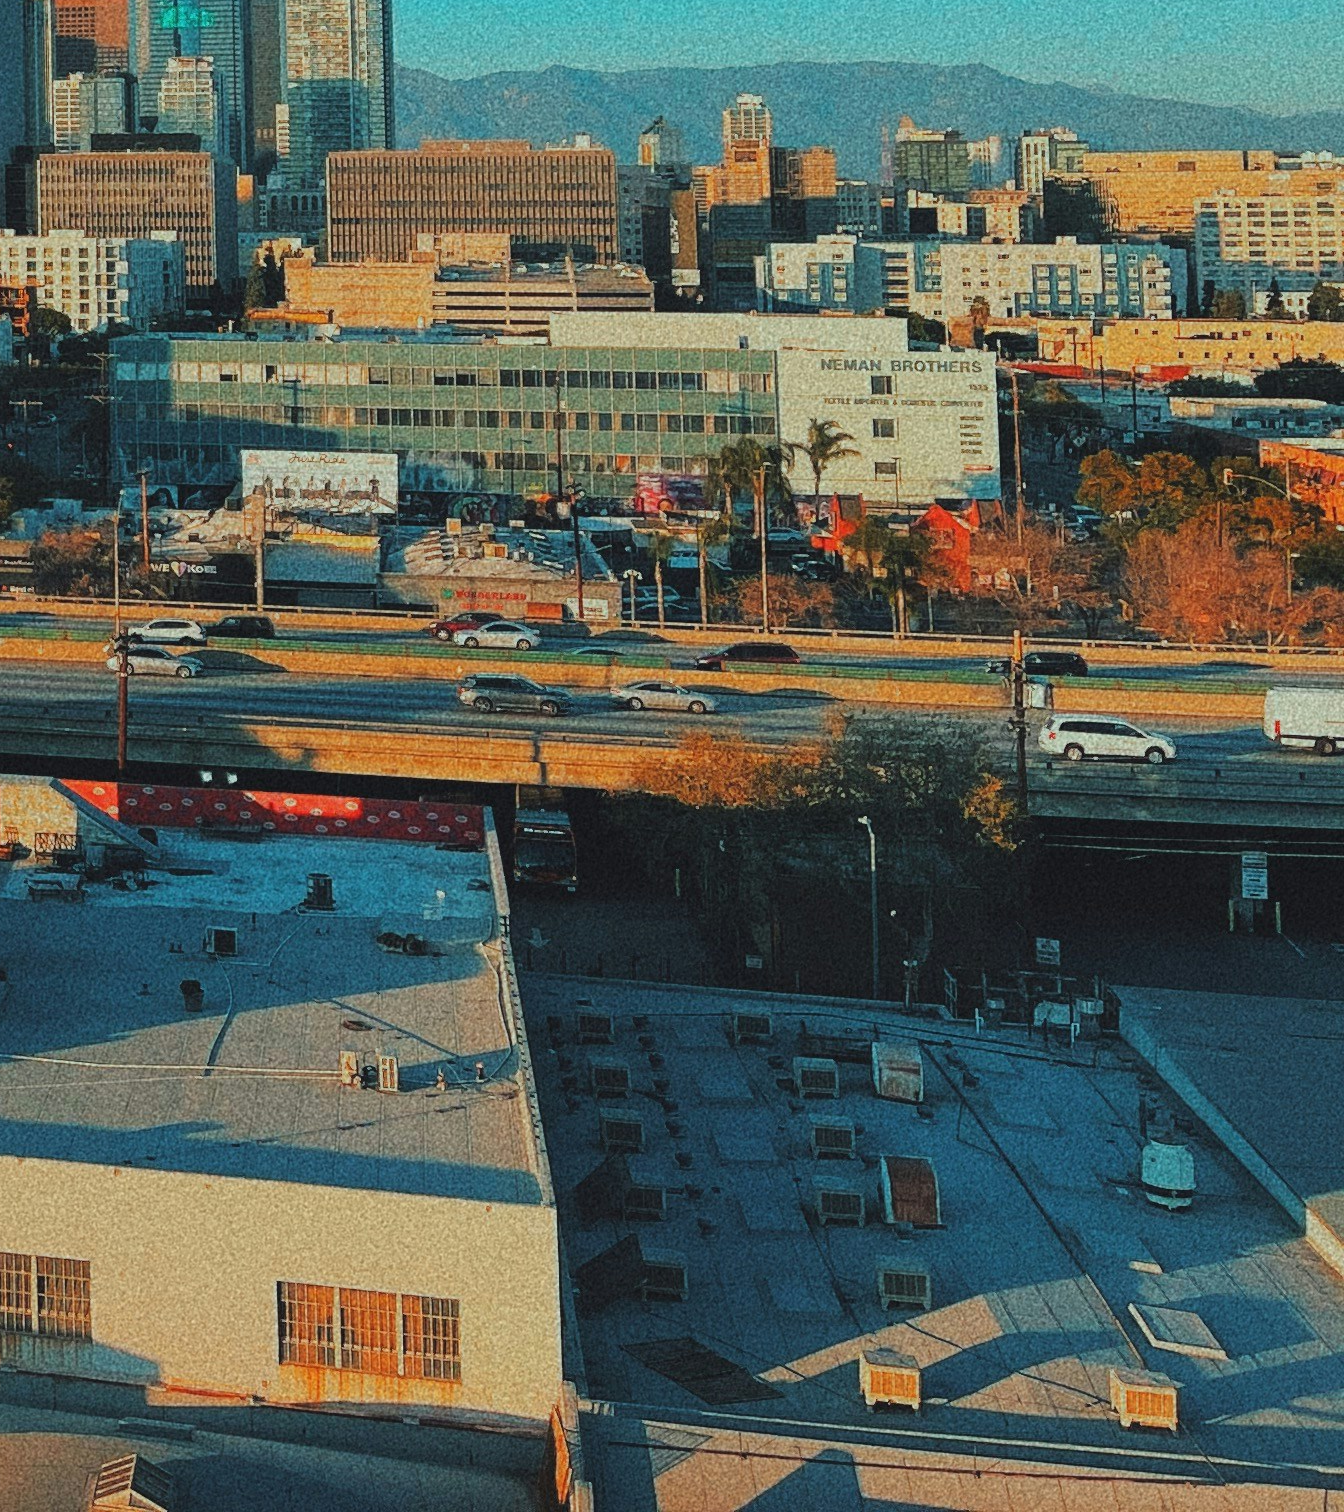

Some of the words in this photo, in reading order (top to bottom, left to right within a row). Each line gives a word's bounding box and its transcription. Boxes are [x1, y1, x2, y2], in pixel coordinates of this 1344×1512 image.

[820, 358, 882, 372] NEMAN
[891, 359, 983, 373] BROTHERS
[150, 562, 170, 573] WE
